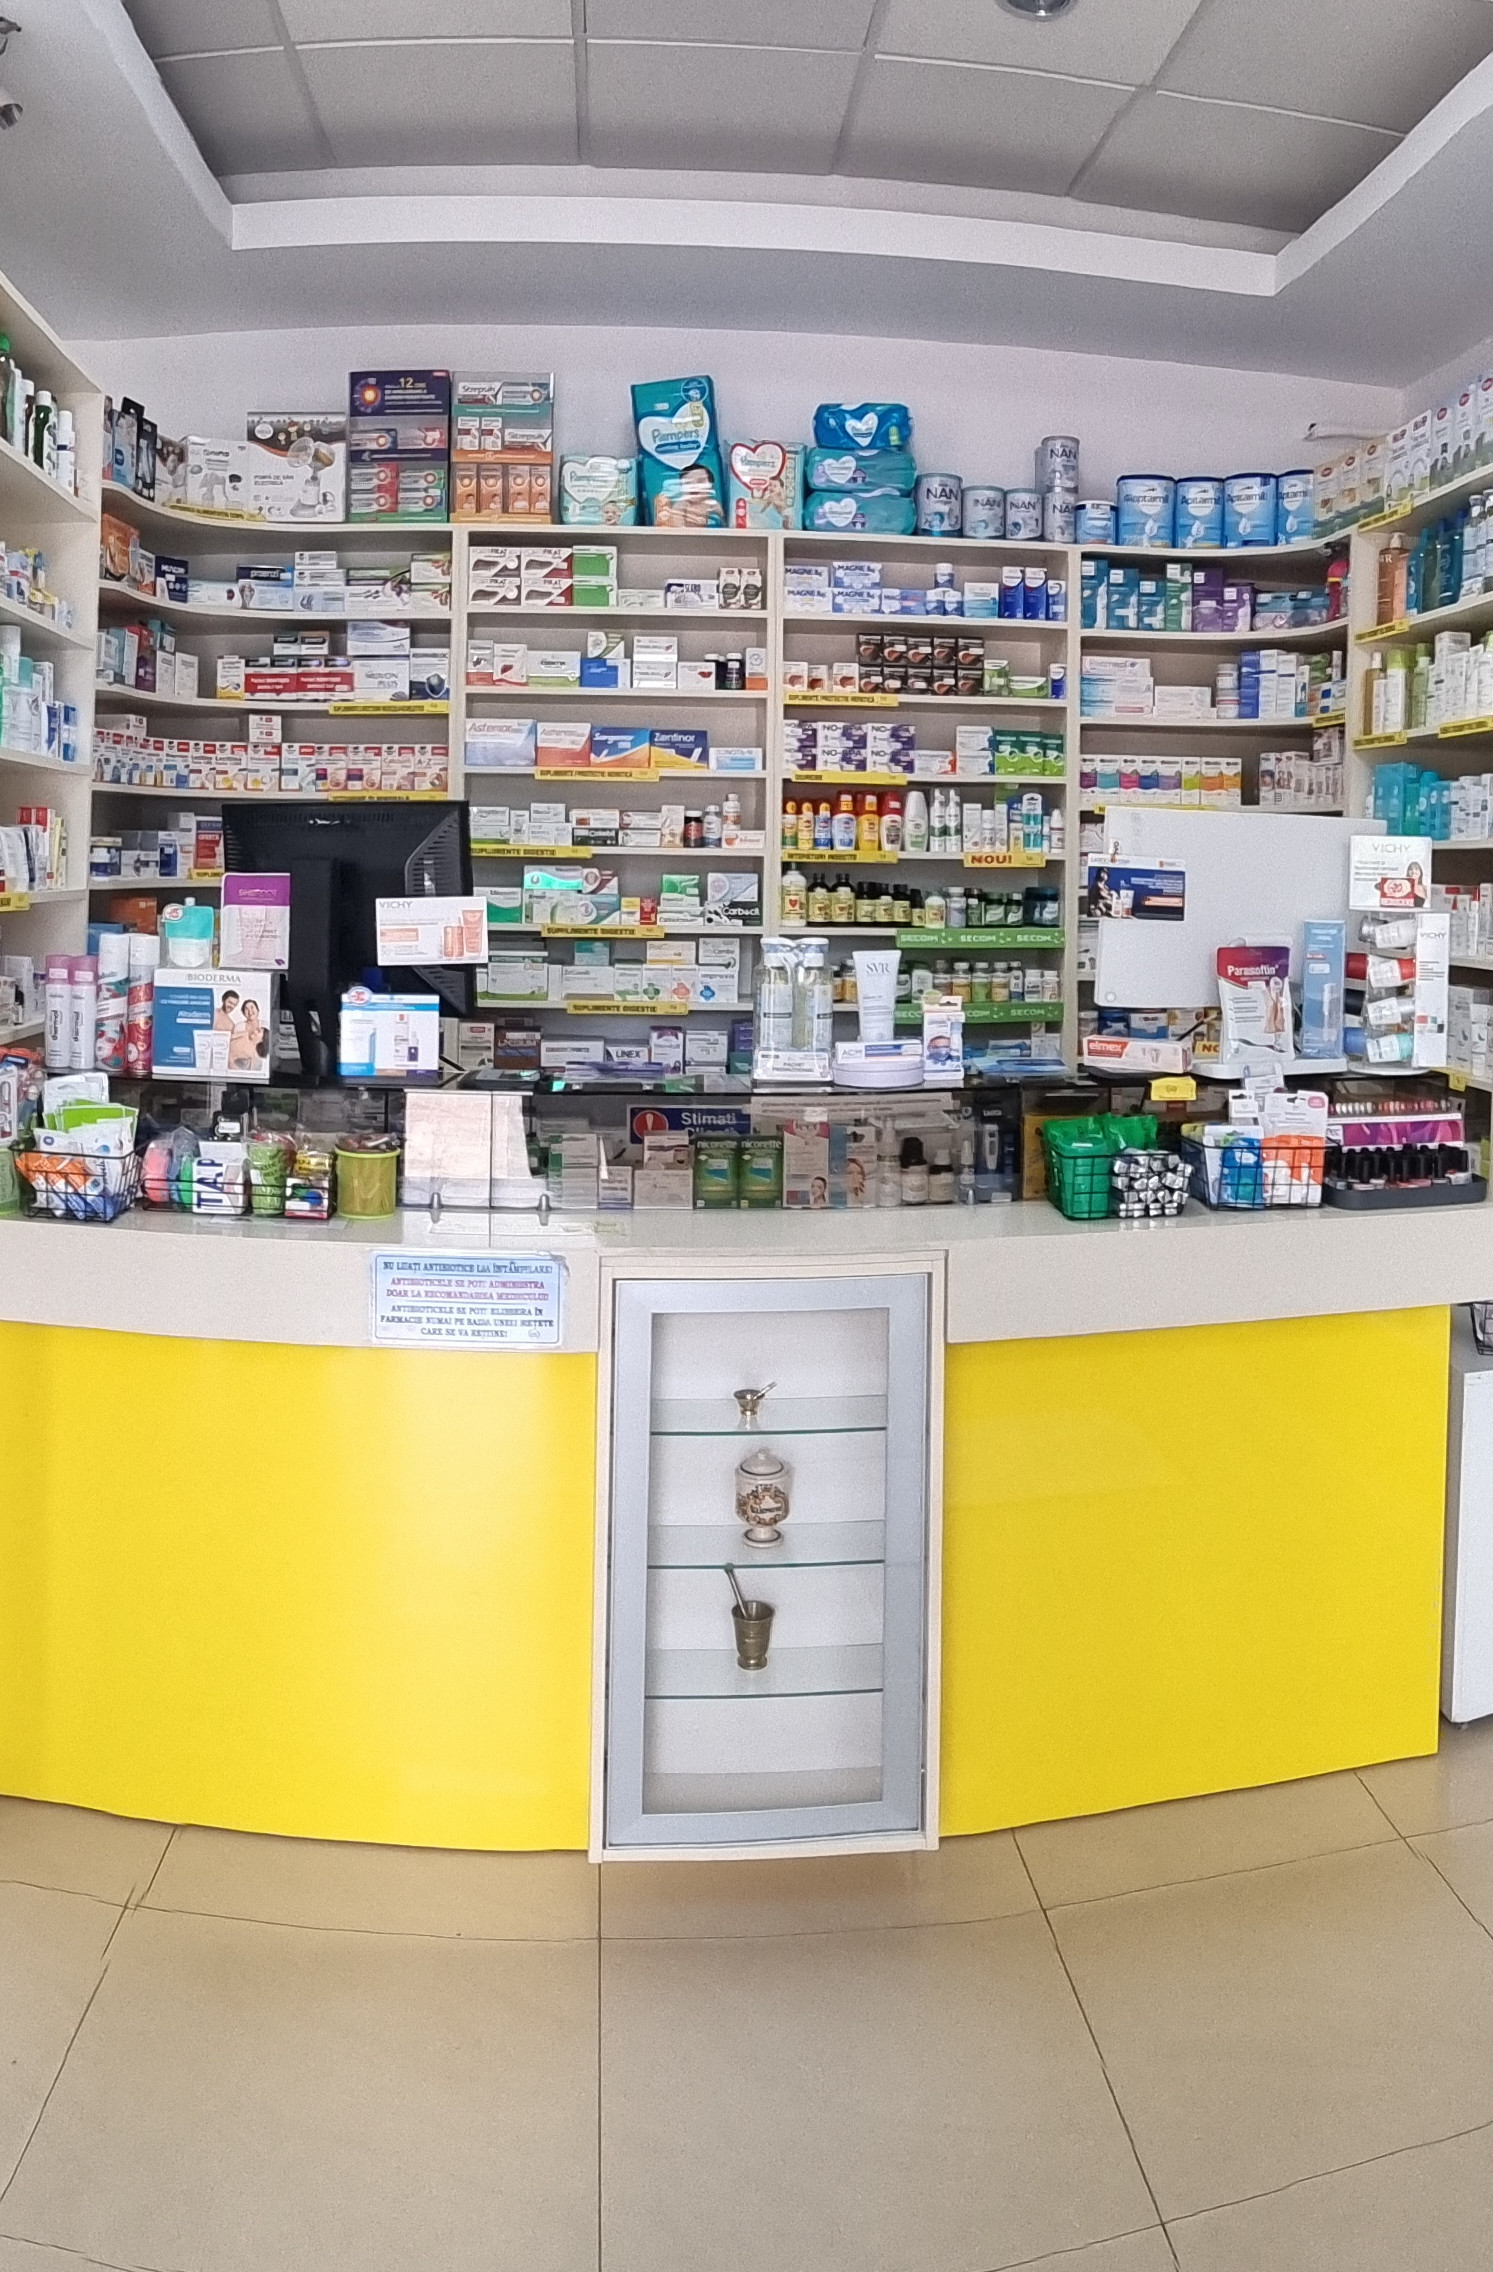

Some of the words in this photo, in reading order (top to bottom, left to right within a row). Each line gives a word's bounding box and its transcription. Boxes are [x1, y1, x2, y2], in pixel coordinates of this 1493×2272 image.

[399, 377, 414, 388] 12
[651, 428, 700, 443] Pampers
[1050, 449, 1077, 460] NAN
[926, 487, 959, 500] NAN
[974, 498, 1001, 508] NAN
[1009, 501, 1036, 511] NAN
[1372, 843, 1412, 854] VICHY
[970, 854, 1013, 864] NOU!
[378, 901, 413, 910] VICHY
[900, 934, 939, 943] SECOM
[960, 934, 996, 943] SECOM
[1016, 934, 1052, 943] SECOM
[866, 962, 890, 974] SVR
[187, 973, 242, 983] BIODERMA
[1010, 1009, 1045, 1017] SECOM
[1089, 1040, 1123, 1052] elmex
[616, 1049, 642, 1058] LINEX
[842, 1049, 863, 1058] ACM
[696, 1140, 738, 1149] nicorette
[740, 1140, 782, 1149] nicorette
[383, 1261, 393, 1270] NU
[423, 1263, 474, 1273] ANTIBIOTICE
[390, 1277, 454, 1287] ANTIBIOTICELE
[455, 1279, 465, 1287] SE
[467, 1280, 487, 1288] POT
[488, 1280, 545, 1289] ADMINISTRA
[386, 1289, 408, 1297] DOAR
[411, 1289, 422, 1298] LA
[424, 1290, 494, 1300] RECOMANDAREA
[496, 1291, 550, 1301] MEDICULUI
[390, 1305, 454, 1314] ANTIBIOTICELE
[456, 1306, 466, 1315] SE
[468, 1307, 487, 1315] POT
[490, 1307, 533, 1316] ELIBERA
[380, 1315, 423, 1324] FARMACIE
[425, 1316, 452, 1325] NUMAI
[454, 1317, 465, 1325] PE
[466, 1317, 491, 1326] BAZA
[493, 1318, 518, 1327] UNEI
[421, 1327, 442, 1335] CARE
[445, 1328, 456, 1336] SE
[458, 1328, 469, 1336] VA
